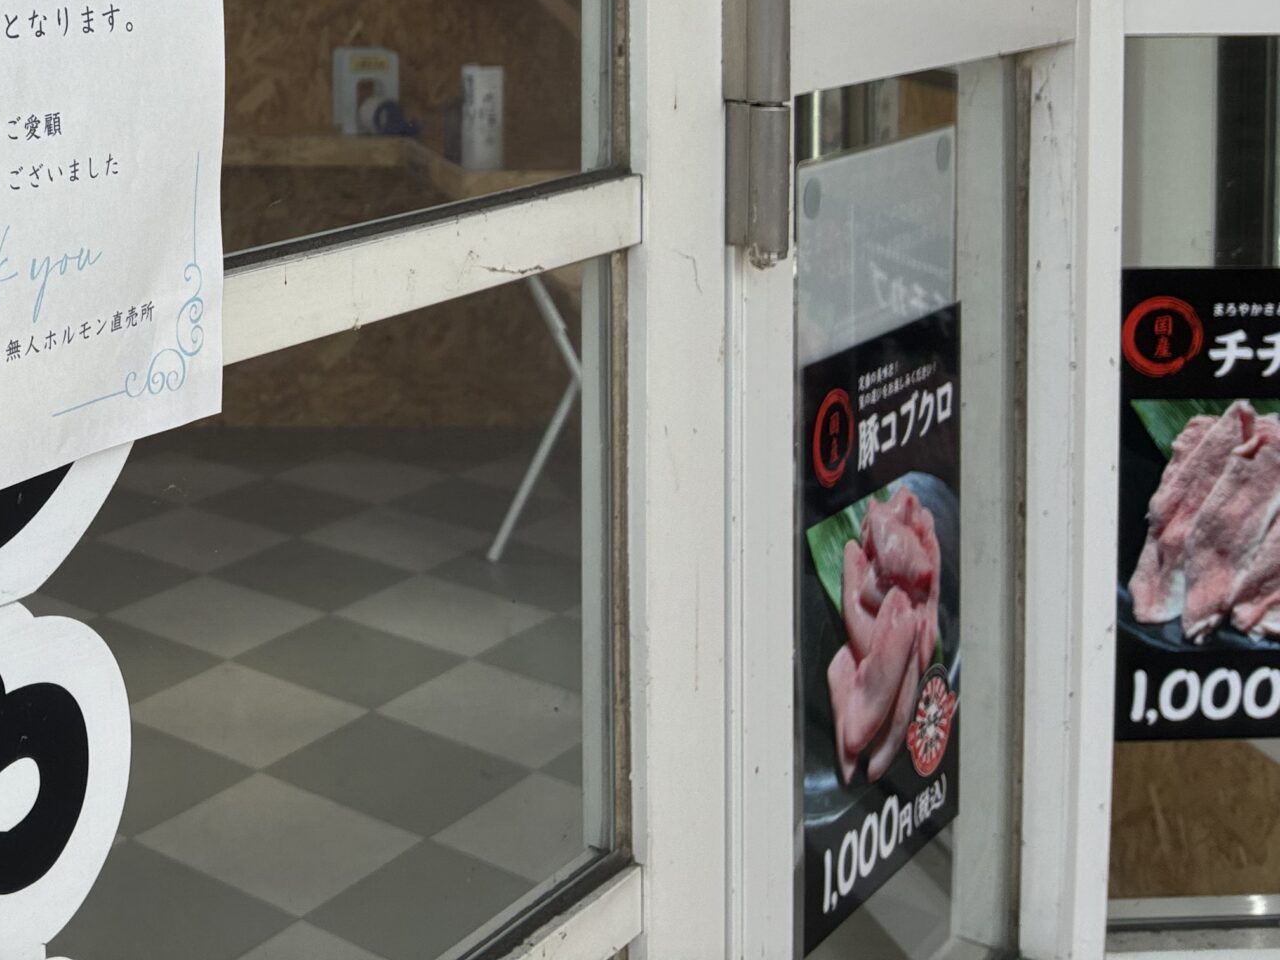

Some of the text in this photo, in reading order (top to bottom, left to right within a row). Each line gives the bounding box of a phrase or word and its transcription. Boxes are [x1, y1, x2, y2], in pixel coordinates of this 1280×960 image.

[29, 247, 103, 324] you
[1213, 302, 1280, 317] まろやかさ
[857, 381, 953, 472] 豚コブクロ
[1130, 666, 1280, 726] 1,000
